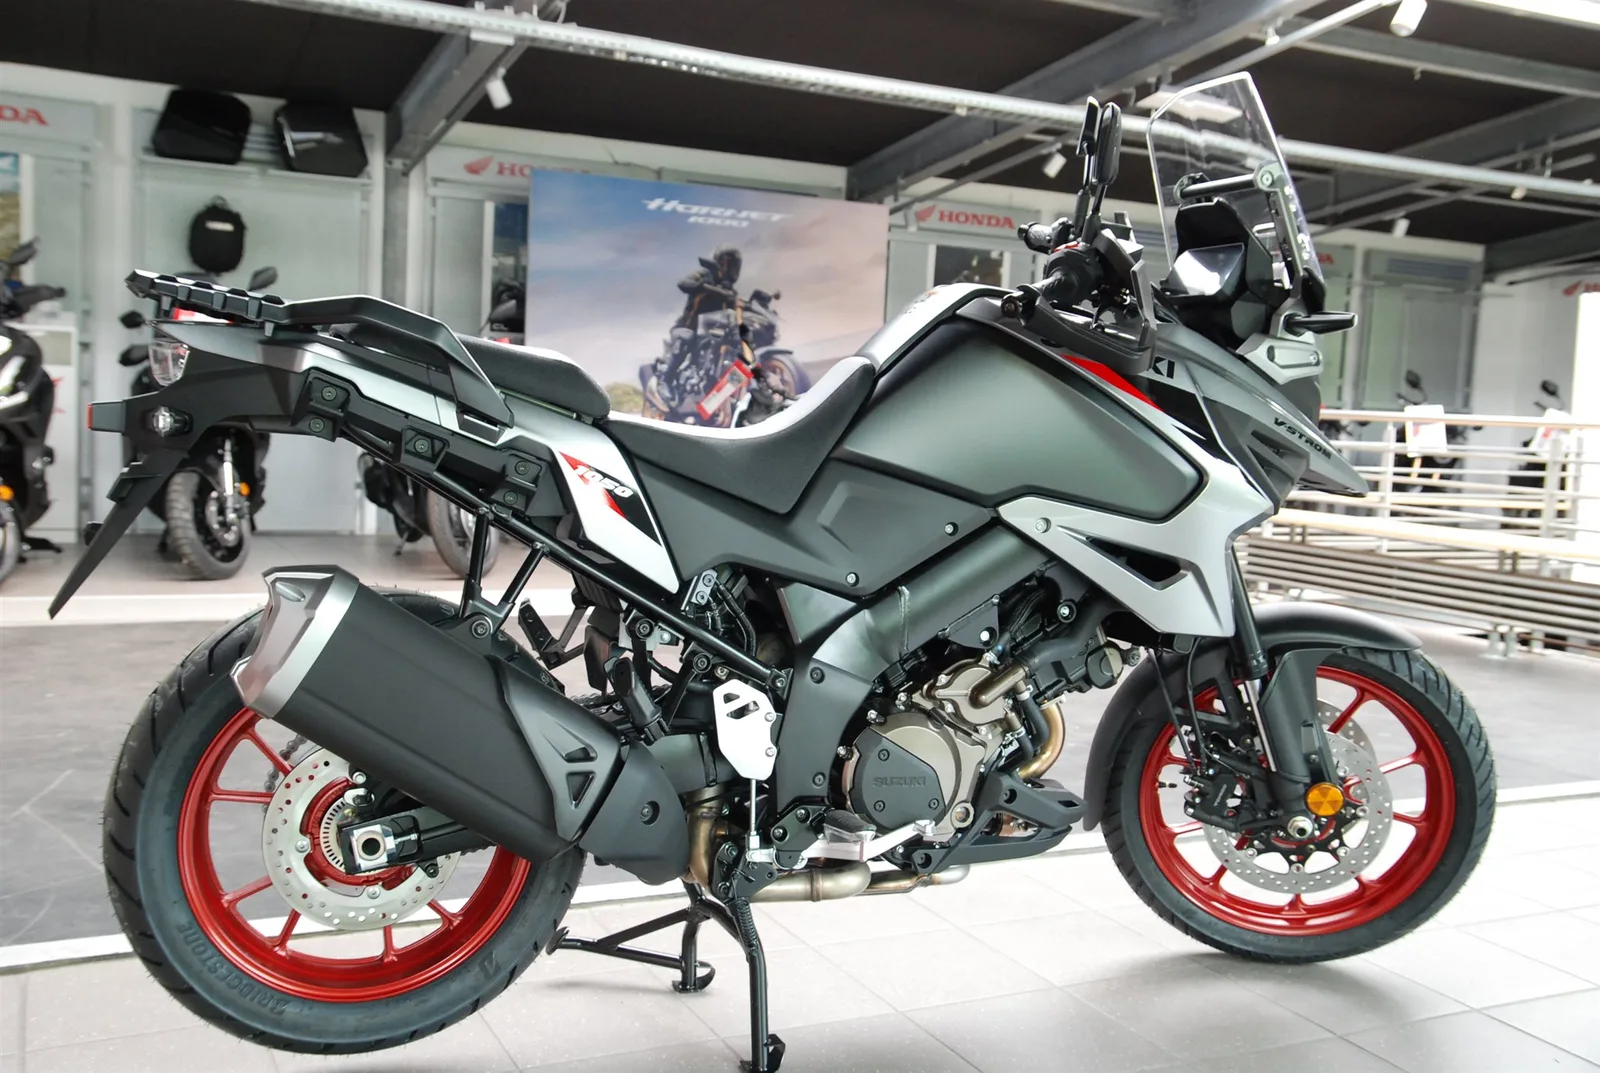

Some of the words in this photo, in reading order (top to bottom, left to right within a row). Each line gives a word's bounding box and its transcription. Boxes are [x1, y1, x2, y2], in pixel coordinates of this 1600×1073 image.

[939, 210, 1016, 229] HONDA
[575, 465, 634, 498] 1050
[872, 776, 926, 788] SUZUKI
[176, 923, 293, 1016] BRIDGESTONE
